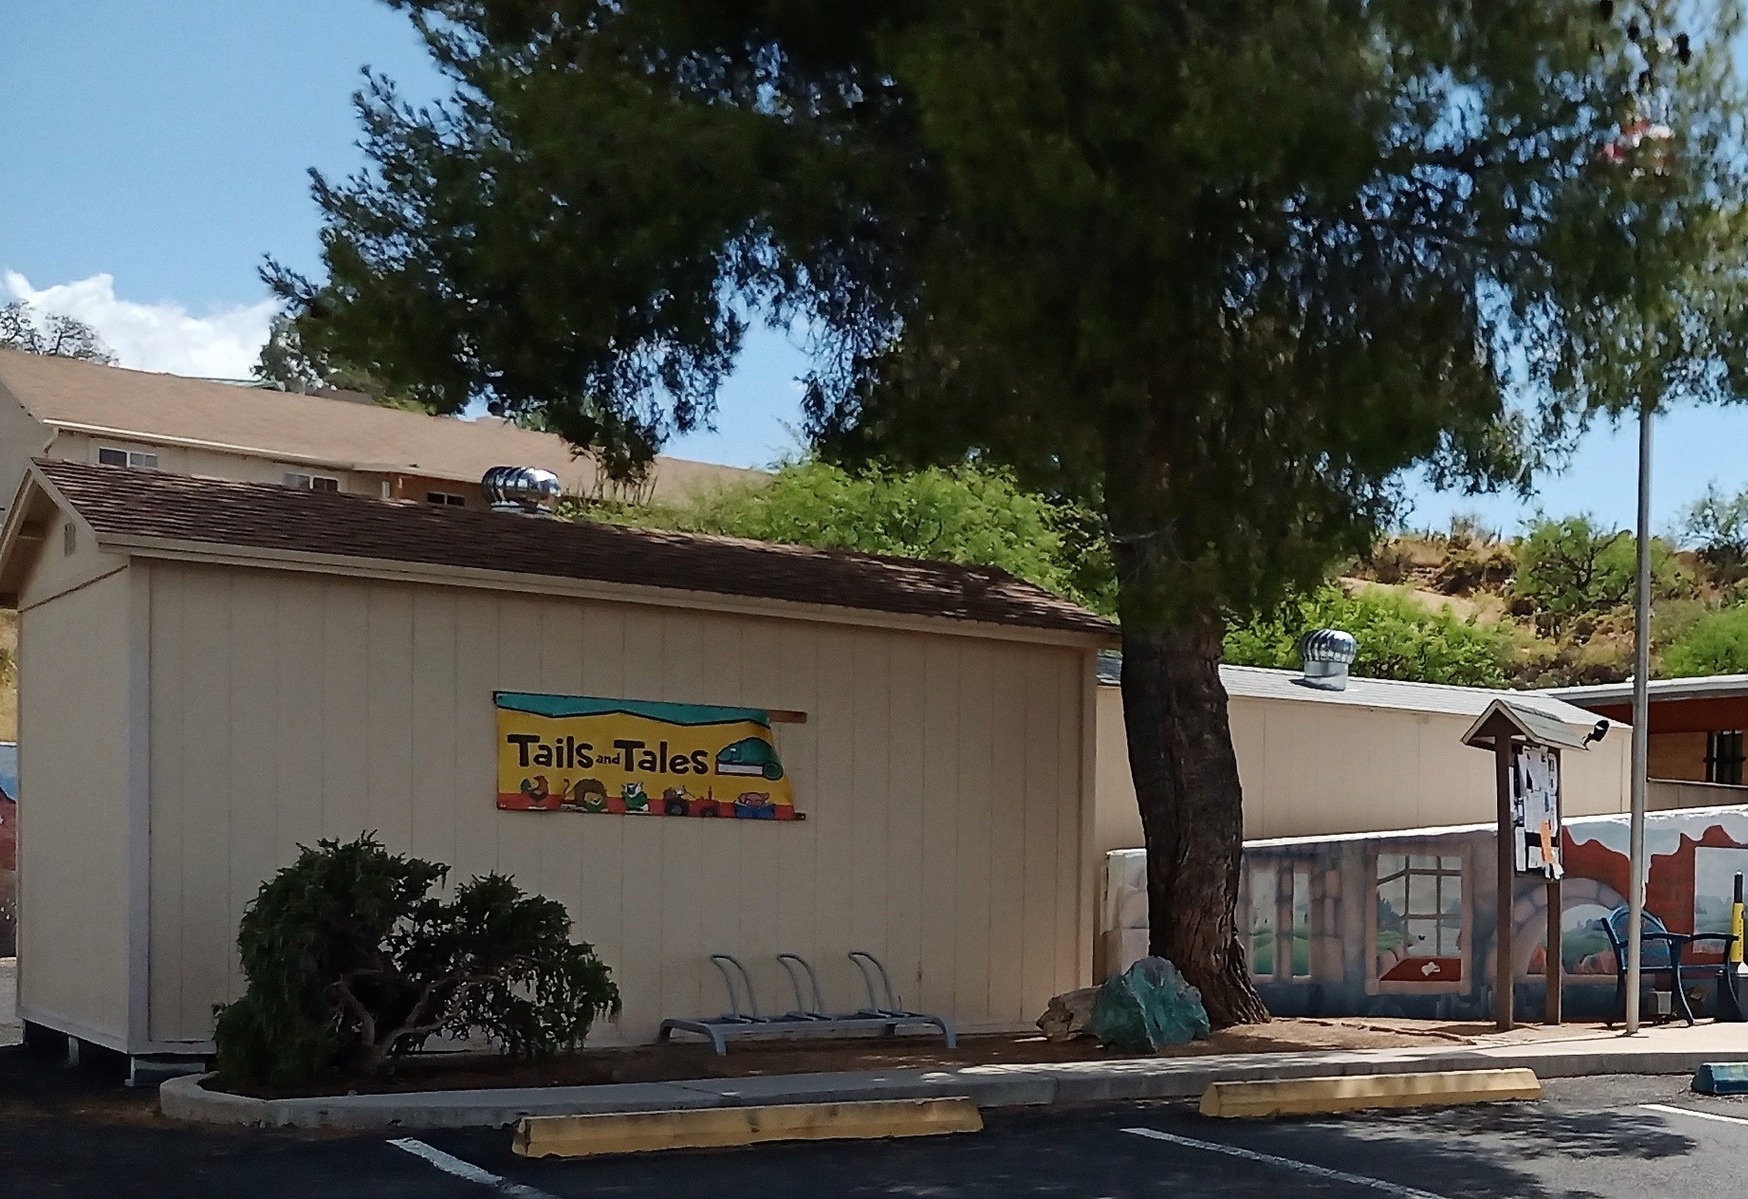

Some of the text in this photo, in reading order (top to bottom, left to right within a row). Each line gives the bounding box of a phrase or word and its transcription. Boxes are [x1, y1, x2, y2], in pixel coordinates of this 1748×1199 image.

[507, 733, 709, 775] Tails and Tales
